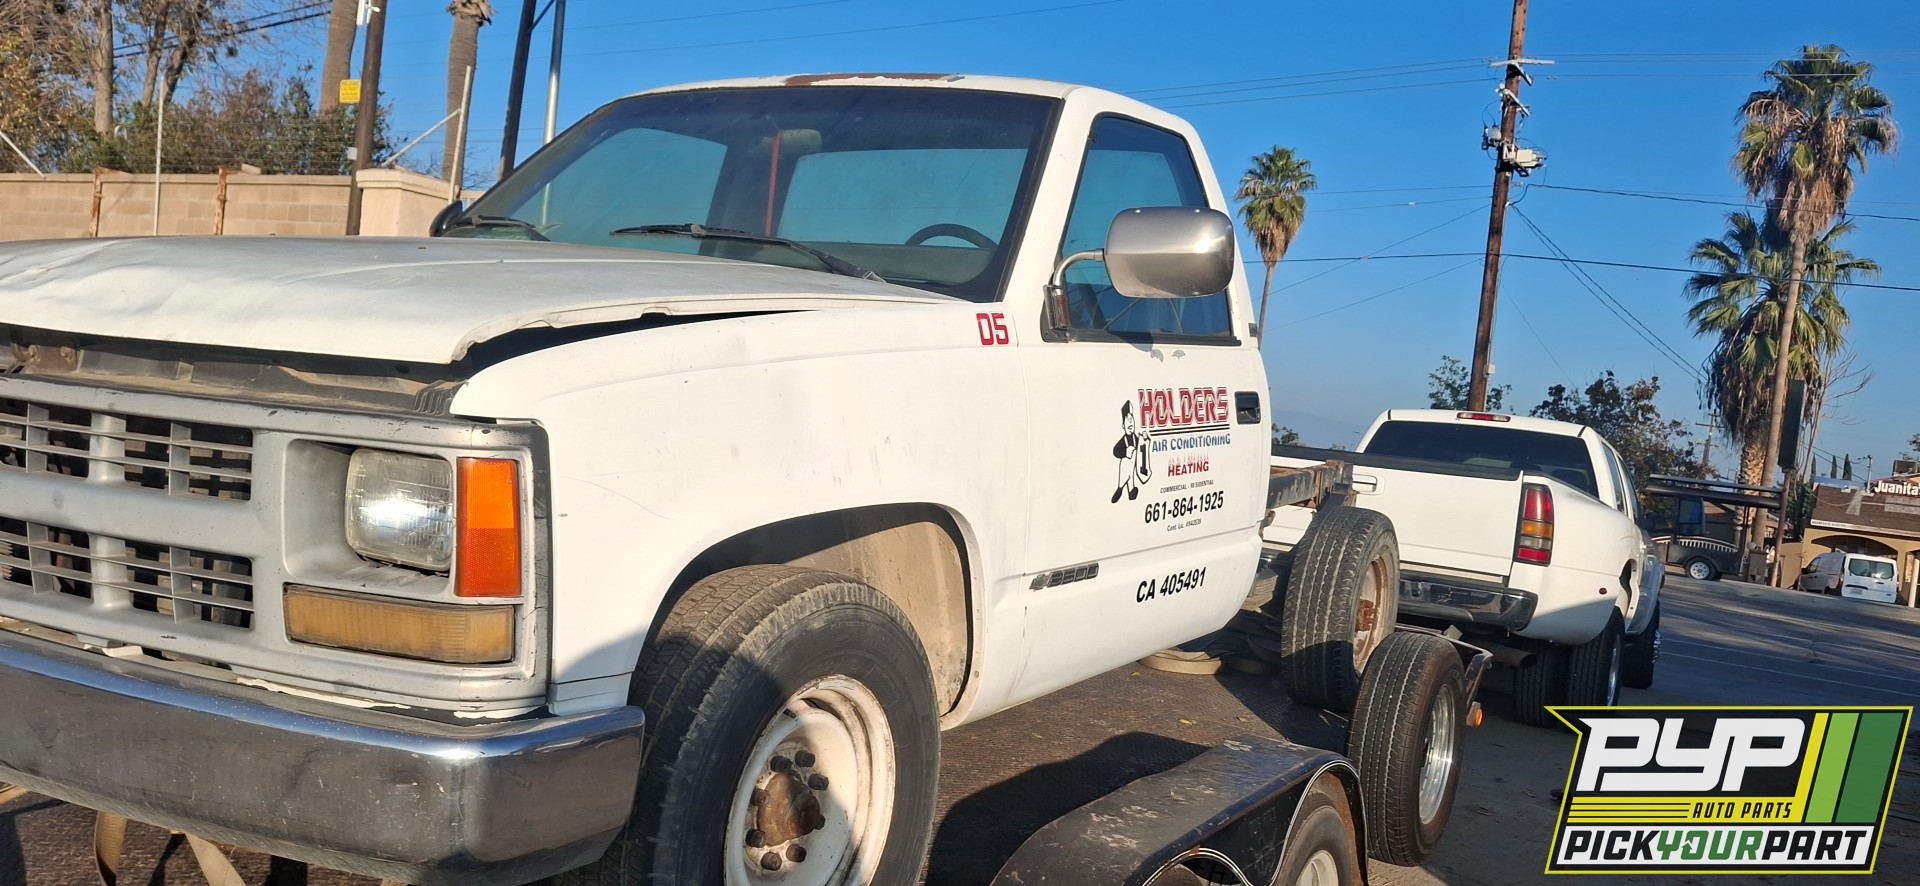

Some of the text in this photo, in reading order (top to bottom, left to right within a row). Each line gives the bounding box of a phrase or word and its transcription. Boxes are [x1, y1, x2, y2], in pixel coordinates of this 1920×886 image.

[1138, 387, 1229, 428] HOLDERS
[1152, 434, 1231, 452] AIR CONDITIONING
[1168, 461, 1209, 477] HEATING
[1160, 484, 1187, 494] COMMERCIAL
[1190, 479, 1214, 489] RESIDENTIAL
[1144, 491, 1224, 524] 661-864-1925
[1137, 567, 1206, 602] CA 405491
